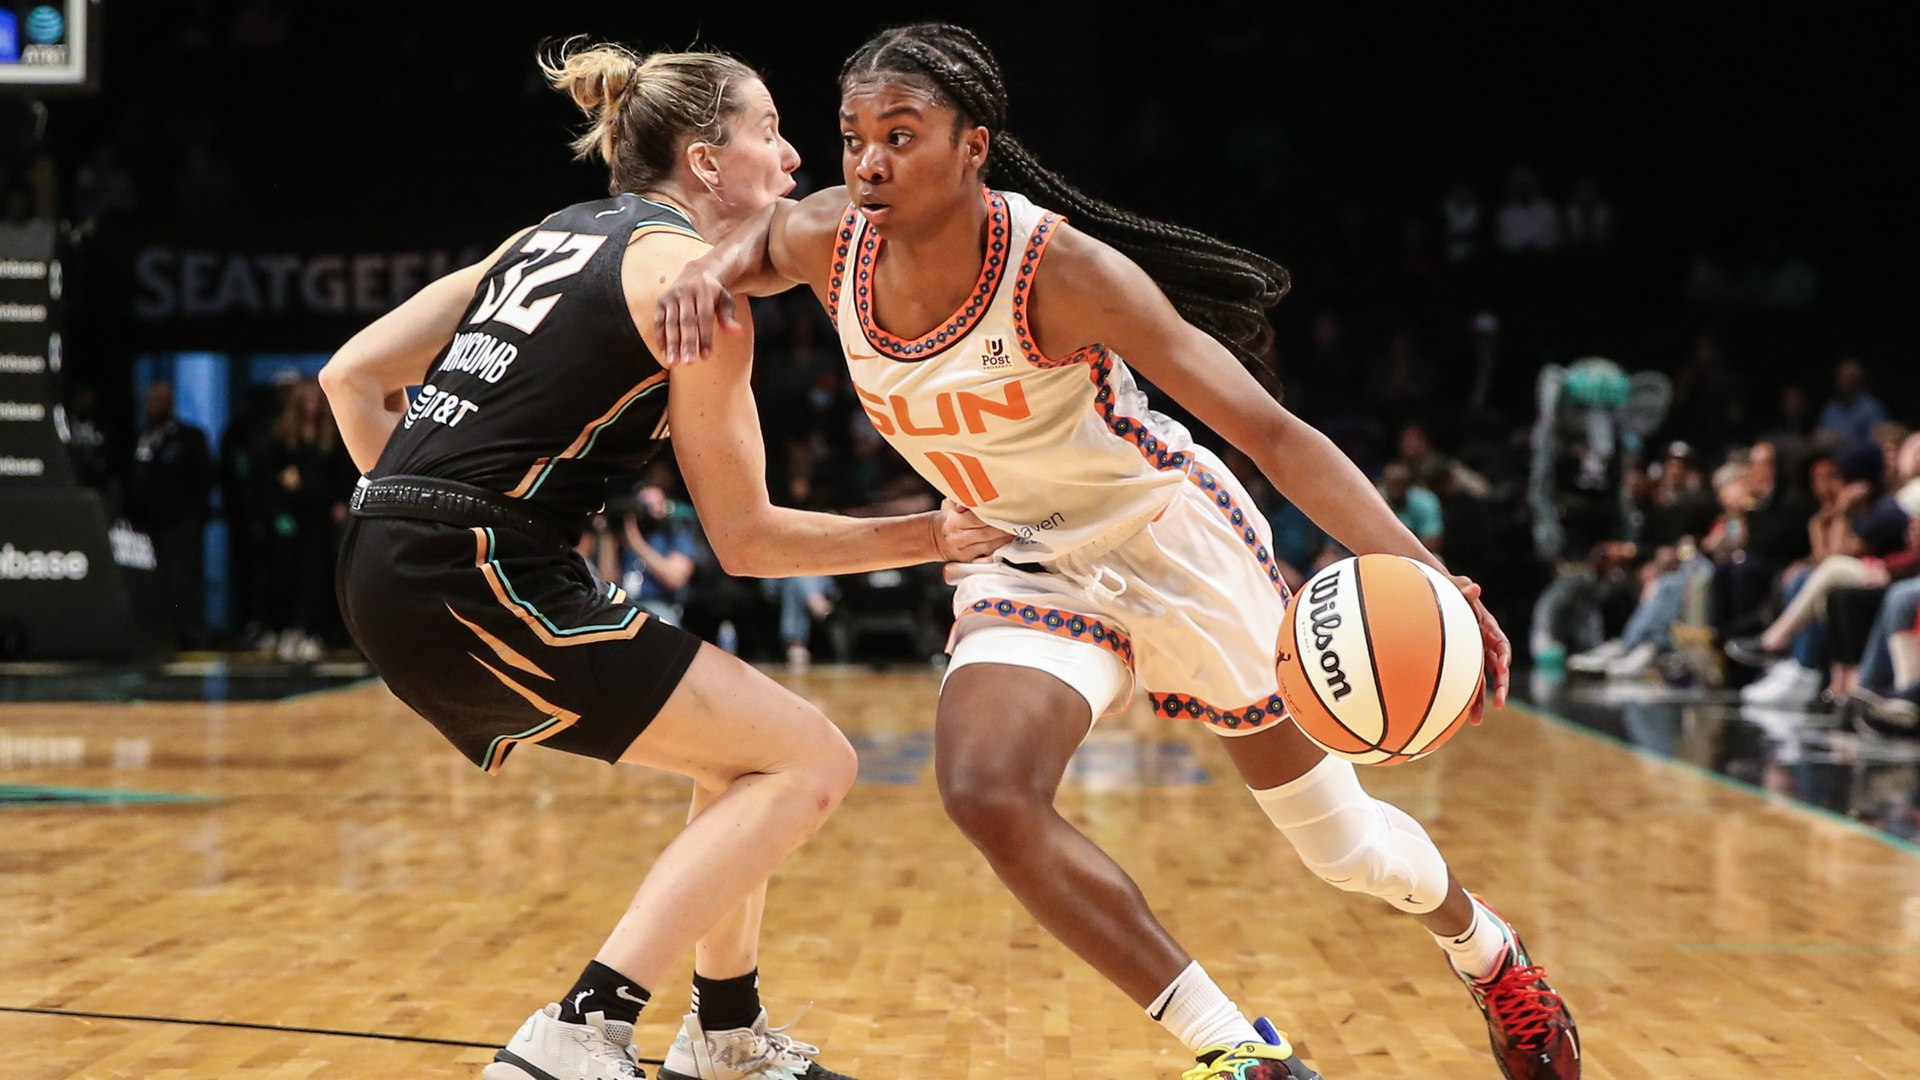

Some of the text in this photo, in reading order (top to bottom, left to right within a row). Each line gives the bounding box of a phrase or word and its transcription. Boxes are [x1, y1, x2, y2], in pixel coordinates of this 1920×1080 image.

[133, 247, 482, 318] SEATGEE
[469, 230, 608, 335] 32
[982, 354, 1011, 366] Post
[852, 380, 1031, 436] SUN
[923, 451, 1000, 507] 11
[1309, 569, 1352, 702] Wilson
